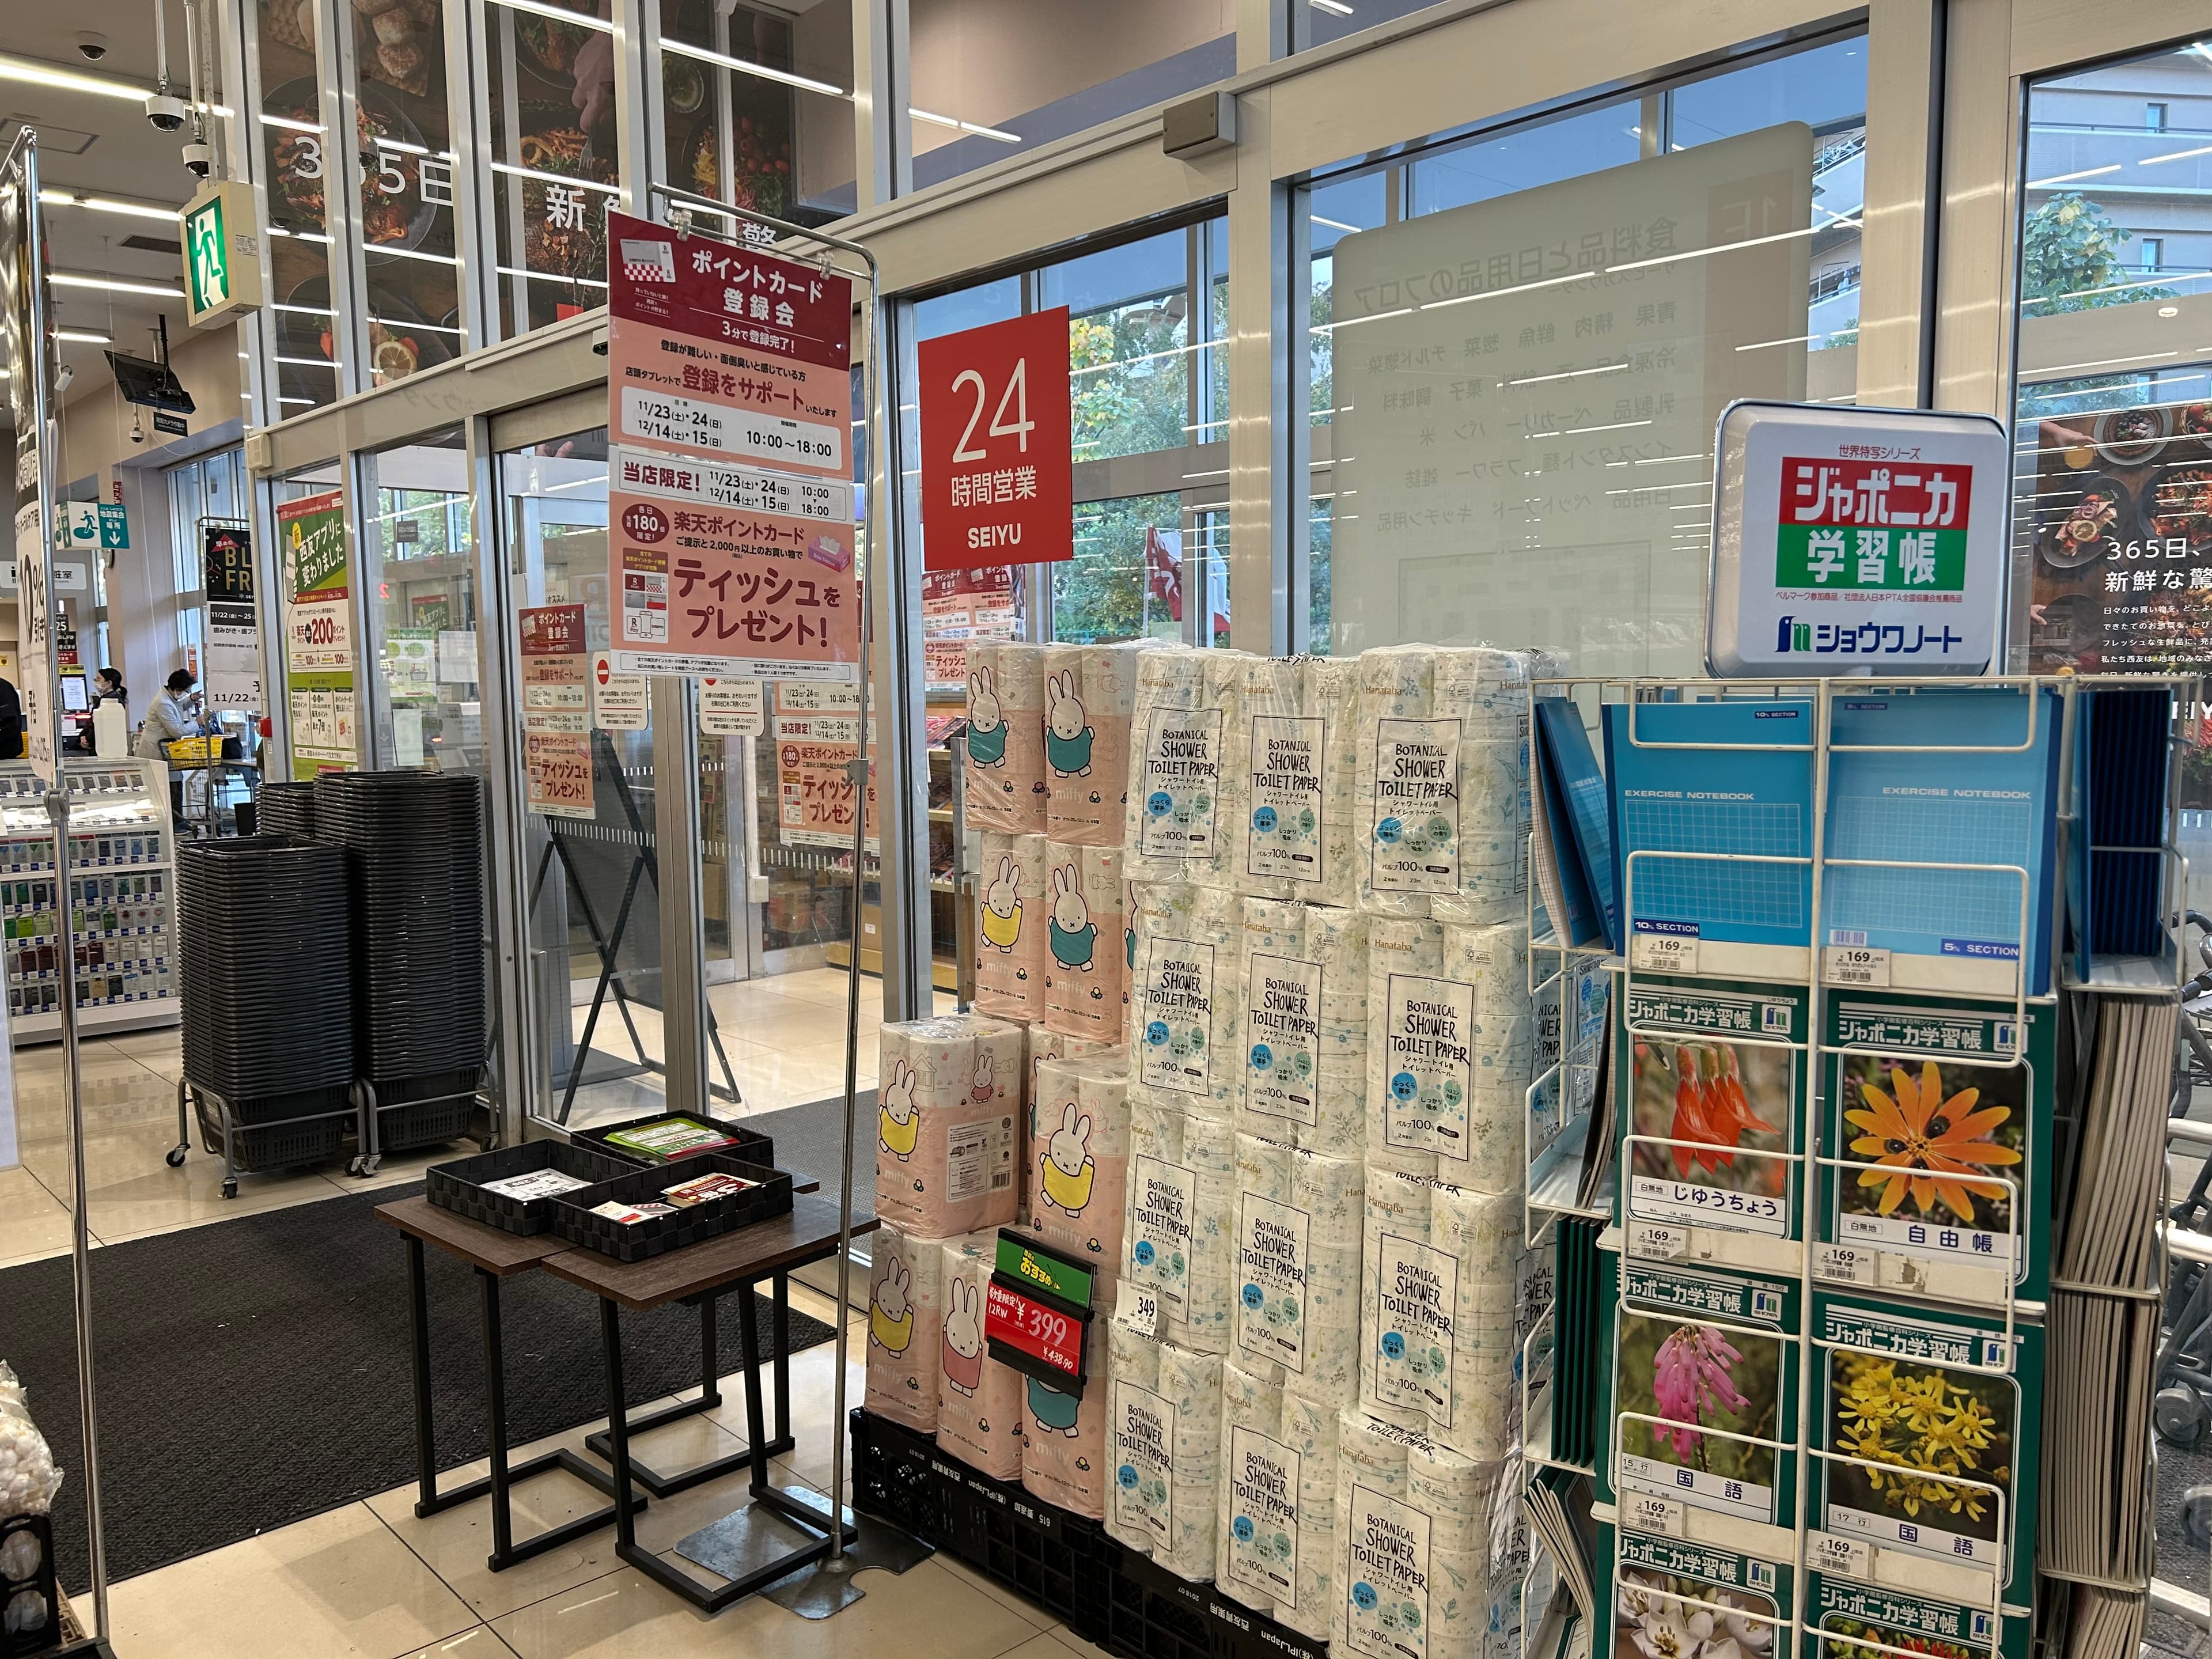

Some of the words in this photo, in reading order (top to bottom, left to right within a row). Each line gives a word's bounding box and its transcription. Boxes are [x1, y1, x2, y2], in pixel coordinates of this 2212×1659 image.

[692, 249, 823, 304] ポイントカード
[724, 287, 794, 328] 登録会
[722, 321, 794, 353] 3分で登録完了!
[952, 357, 1035, 463] 24
[1839, 444, 1921, 460] 世界特写シリーズ
[623, 461, 699, 492] 当店限定!
[951, 465, 1036, 507] 時間営業
[801, 486, 829, 498] 10:00
[1795, 466, 1957, 525] ジャポニカ
[801, 503, 829, 516] 18:00
[633, 515, 658, 532] 180
[674, 512, 804, 545] 楽天ポイントカード
[968, 523, 1021, 548] SEIYU
[300, 518, 341, 562] 西友アプリに
[302, 543, 344, 588] 変わりました
[1807, 529, 1937, 585] 学習帳
[674, 559, 840, 608] ティッシュを
[539, 611, 575, 624] ポイントカード
[687, 605, 827, 647] プレゼント!
[312, 617, 333, 644] 200
[1816, 622, 1962, 653] ショウワノート
[1366, 685, 1402, 696] Hanataba
[1162, 729, 1208, 740] BOTANICAL
[1161, 741, 1207, 759] SHOWER
[1396, 744, 1447, 756] BOTANICAL
[542, 760, 588, 779] ティッシュを
[1148, 760, 1187, 775] TOILET
[1189, 762, 1218, 778] PAPER
[1393, 758, 1445, 778] SHOWER
[546, 782, 585, 800] プレゼント!
[1056, 789, 1084, 804] miffy
[1378, 781, 1422, 798] TOILET
[1423, 782, 1457, 800] PAPER
[1625, 790, 1682, 798] EXERCISE
[1687, 791, 1755, 800] NOTEBOOK
[1883, 787, 1948, 796] EXERCISE
[1954, 789, 2031, 799] NOTEBOOK
[1656, 923, 1699, 933] SECTION
[1660, 941, 1679, 950] 169
[1847, 951, 1869, 962] 169
[1967, 944, 2018, 956] SECTION
[987, 960, 1013, 977] miffy
[1058, 978, 1086, 997] miffy
[1266, 978, 1308, 995] BOTANICAL
[1264, 991, 1308, 1016] SHOWER
[1407, 1000, 1457, 1018] BOTANICAL
[1630, 1000, 1751, 1029] ジャポニカ学習帳
[1251, 1010, 1286, 1030] TOILET
[1288, 1016, 1318, 1038] PAPER
[1405, 1014, 1456, 1041] SHOWER
[1839, 1020, 1982, 1051] ジャポニカ学習帳
[1390, 1036, 1432, 1056] TOILET
[1435, 1040, 1469, 1066] PAPER
[1673, 1184, 1777, 1215] じゆうちょう
[1255, 1218, 1296, 1242] BOTANICAL
[1648, 1230, 1668, 1240] 169
[1909, 1225, 1992, 1253] 自由帳
[1253, 1232, 1296, 1263] SHOWER
[1832, 1249, 1854, 1261] 169
[1243, 1248, 1275, 1272] TOILET
[1276, 1262, 1305, 1287] PAPER
[988, 1302, 1007, 1319] 12RW
[1138, 1297, 1154, 1317] 349
[1826, 1322, 1969, 1365] ジャポニカ学習帳
[874, 1362, 903, 1383] miffy
[948, 1401, 975, 1426] miffy
[1036, 1441, 1070, 1465] miffy
[1338, 1445, 1373, 1466] Hanataba
[1677, 1469, 1742, 1499] 国語
[1645, 1501, 1665, 1513] 169
[1039, 1514, 1050, 1527] 615
[1368, 1514, 1416, 1544] BOTANICAL
[1366, 1528, 1415, 1567] SHOWER
[1827, 1539, 1849, 1552] 169
[1899, 1524, 1973, 1556] 国語
[1353, 1544, 1392, 1575] TOILET
[1393, 1559, 1428, 1593] PAPER
[1821, 1588, 1959, 1635] ジャポニカ学習帳
